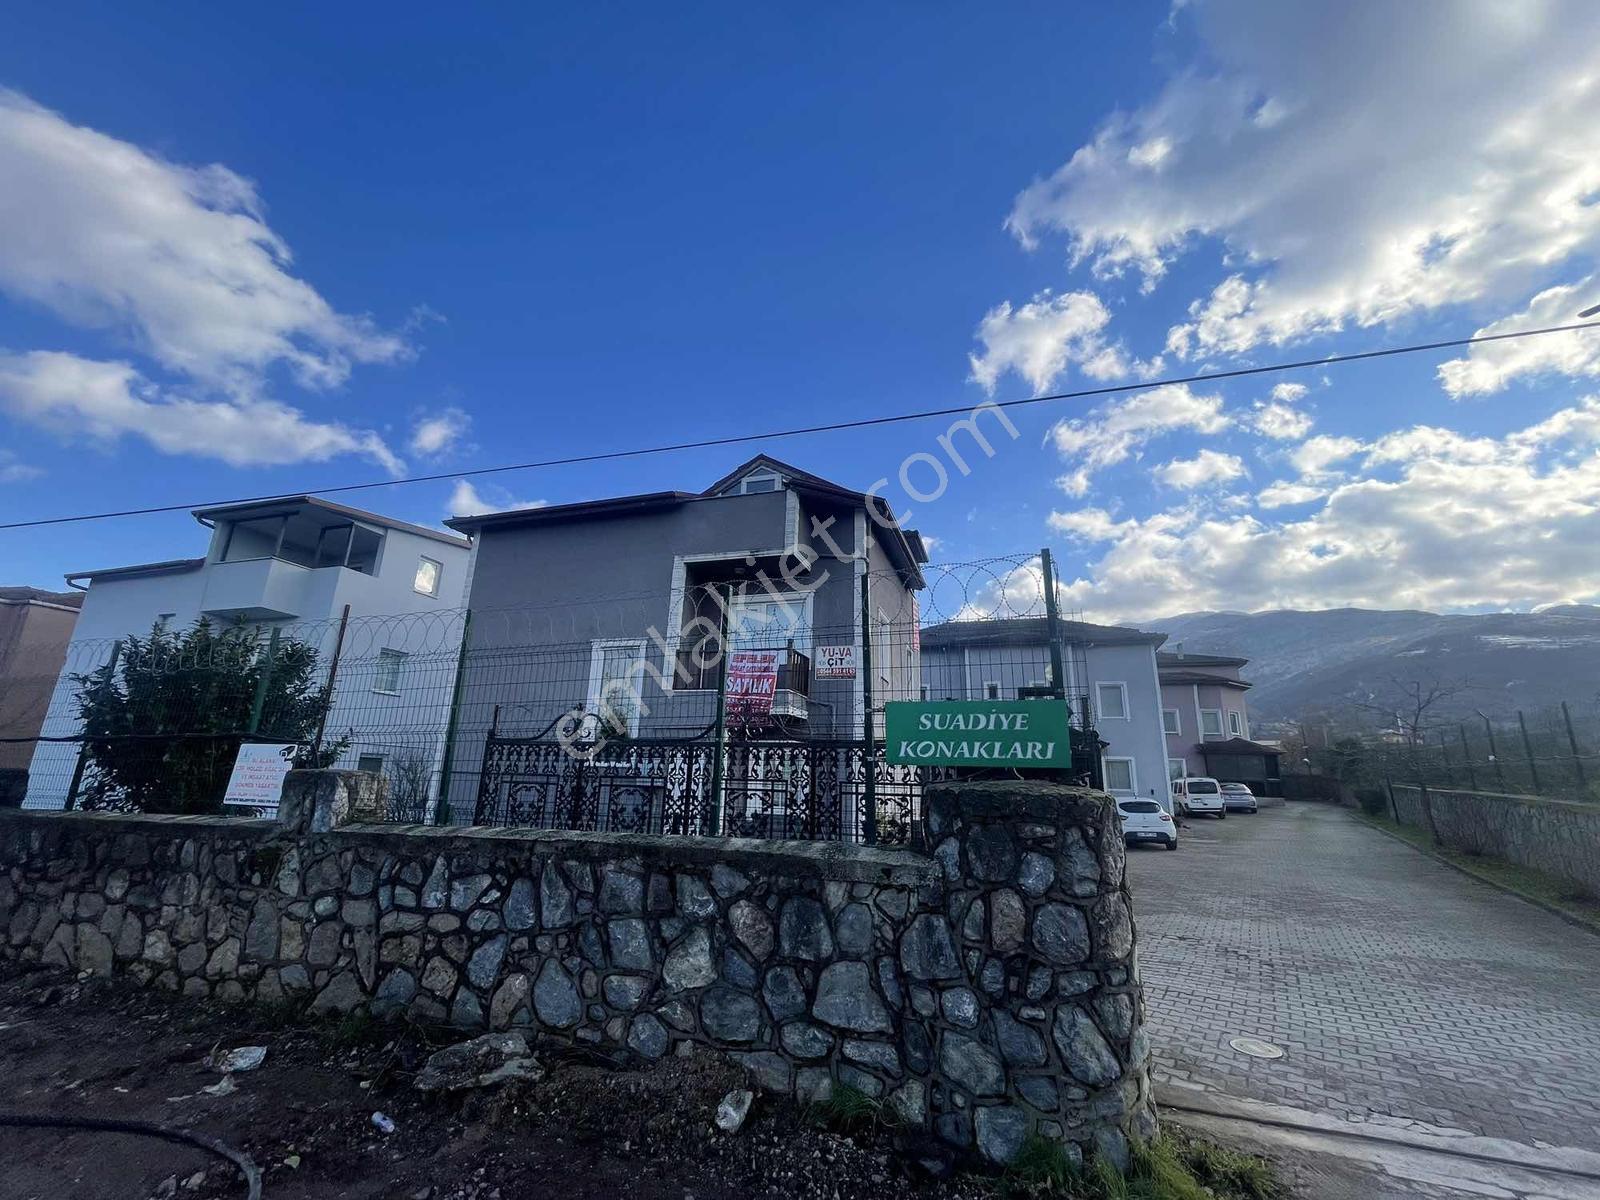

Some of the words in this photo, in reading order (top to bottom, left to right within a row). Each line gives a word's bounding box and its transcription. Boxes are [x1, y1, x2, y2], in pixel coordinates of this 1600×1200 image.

[822, 647, 852, 658] YU-VA
[726, 676, 771, 693] SATILIK
[919, 708, 1029, 730] SUADİYE
[899, 740, 1055, 760] KONAKLARI
